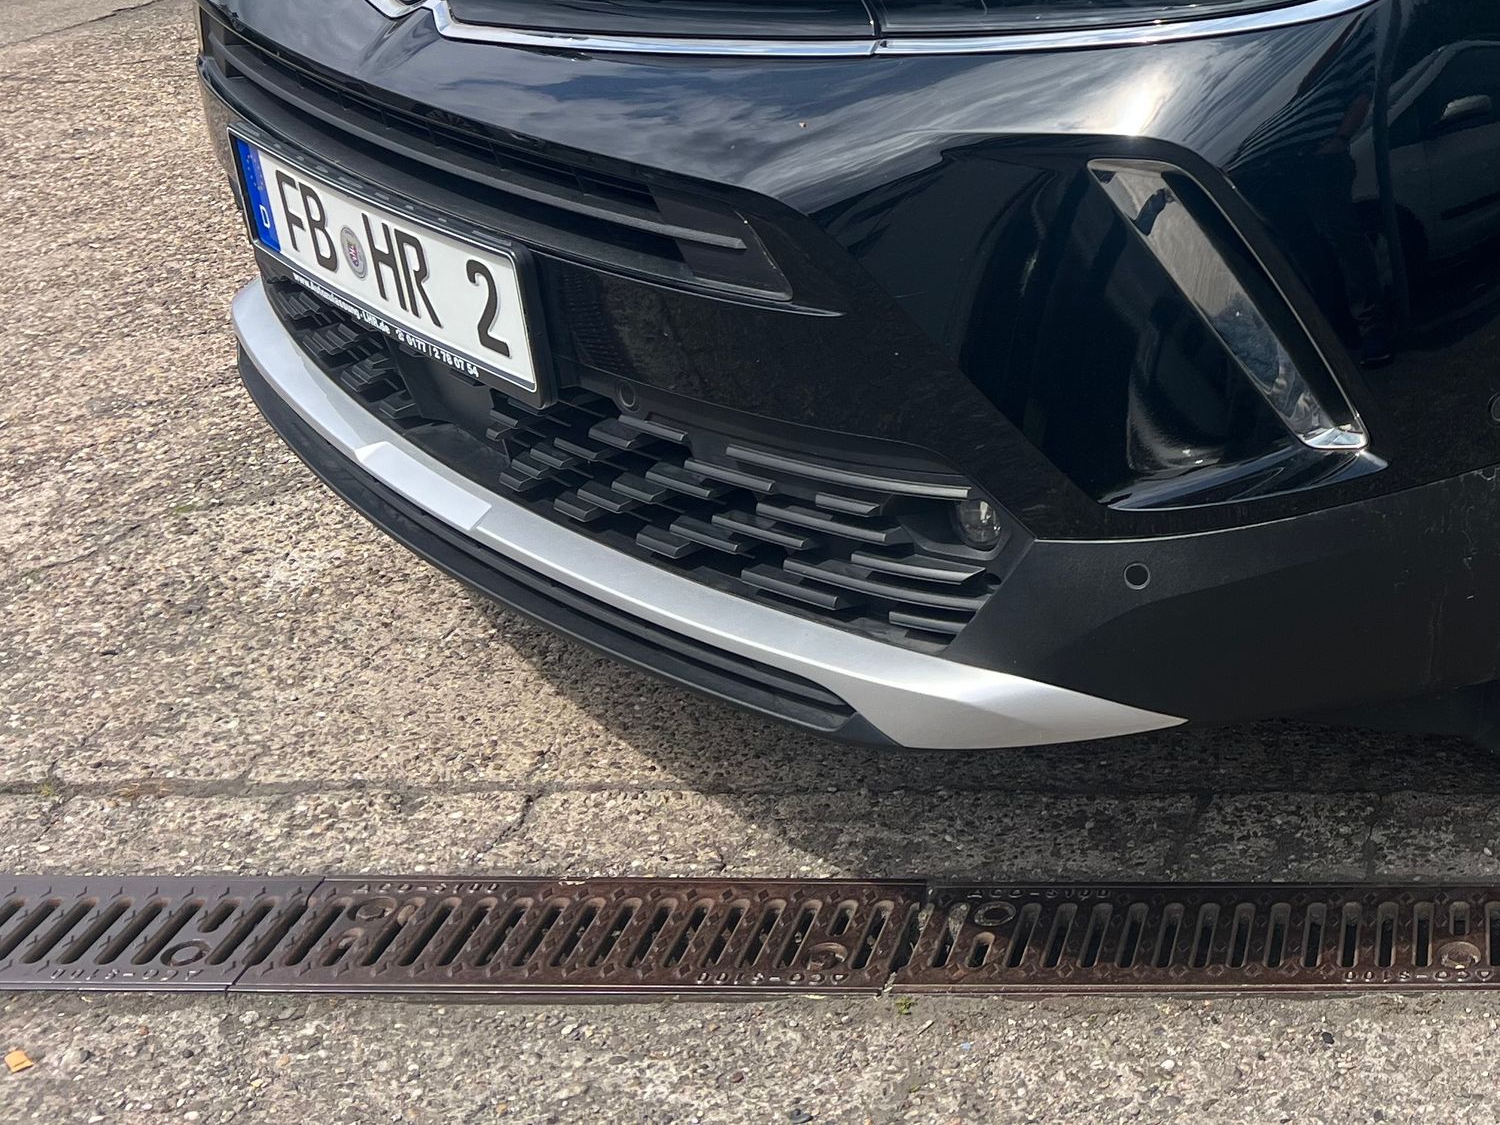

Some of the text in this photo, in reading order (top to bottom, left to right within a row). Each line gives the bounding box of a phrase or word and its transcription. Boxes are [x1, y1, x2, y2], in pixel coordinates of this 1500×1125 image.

[259, 203, 271, 230] D
[275, 169, 512, 359] FB HR 2
[405, 333, 427, 353] 0177
